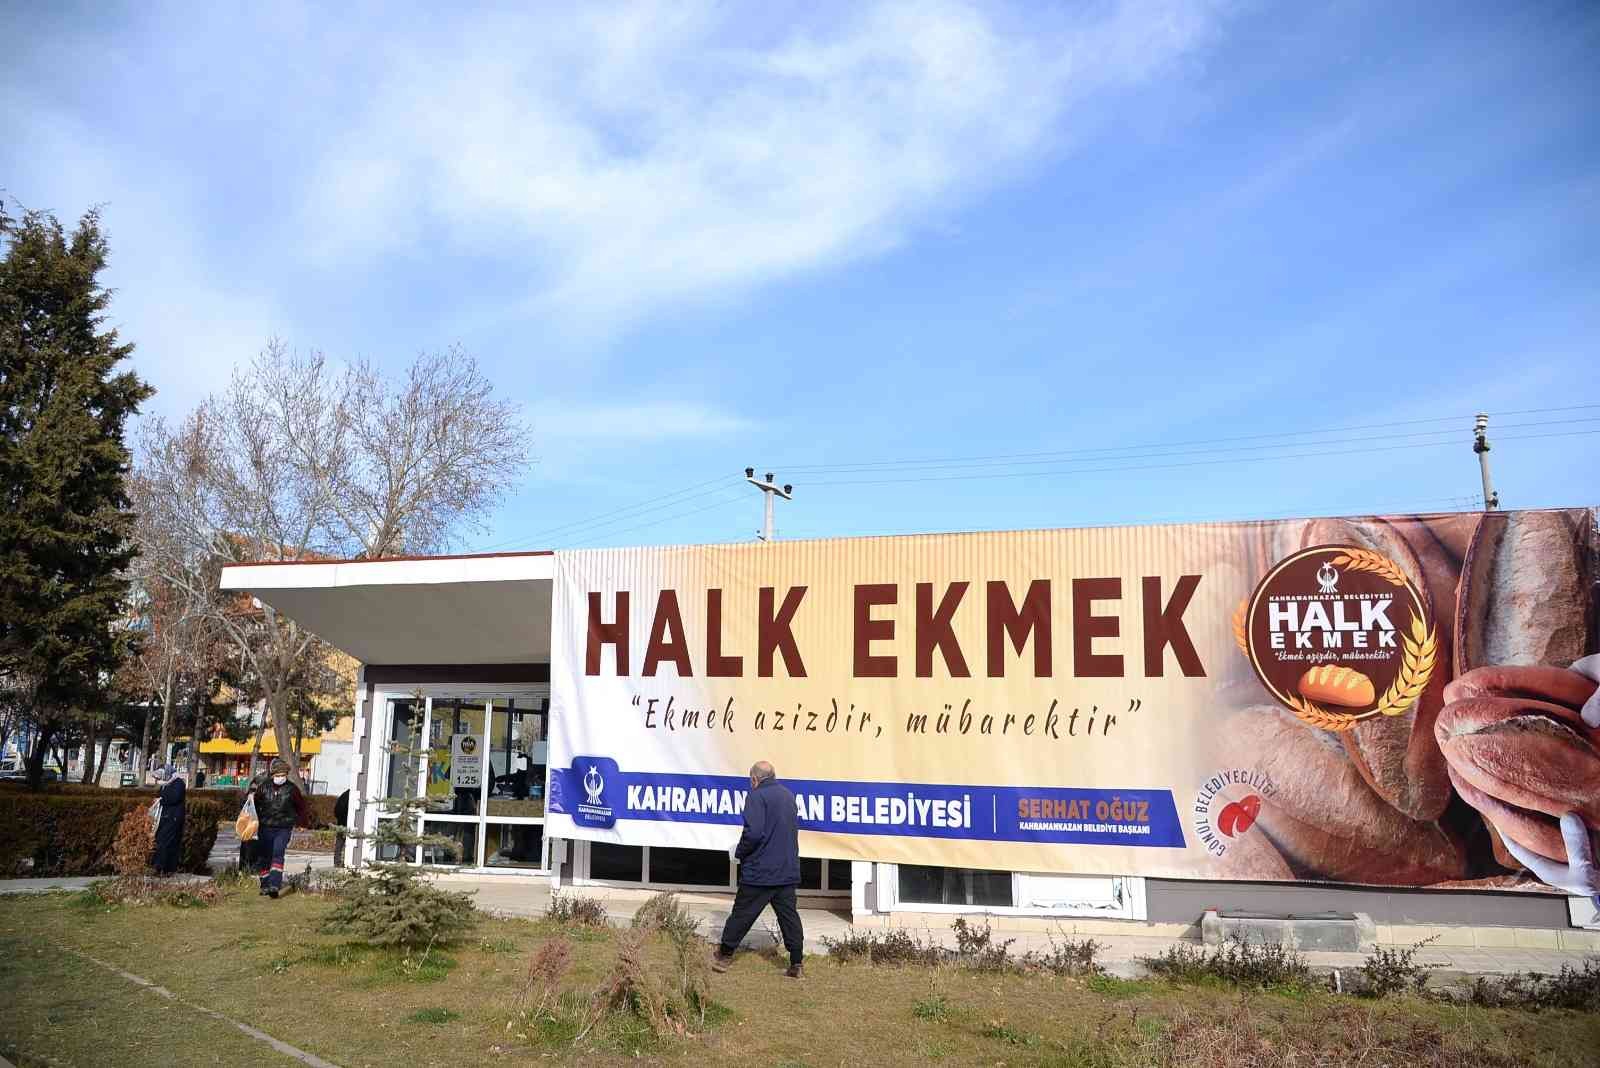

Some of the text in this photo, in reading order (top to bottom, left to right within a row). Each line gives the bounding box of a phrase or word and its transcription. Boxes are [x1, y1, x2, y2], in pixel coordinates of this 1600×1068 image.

[585, 574, 1208, 678] HALK EKMEK
[1268, 599, 1396, 632] HALK
[1270, 630, 1398, 649] EKMEK
[754, 697, 883, 739] azizdir,
[627, 784, 971, 828] KAHRAMANAN BELEDİYESİ
[1018, 793, 1149, 822] SERHAT OĞUZ
[1019, 821, 1151, 836] KAHRAMANKAZAN BELEDİYE BAŞKANI
